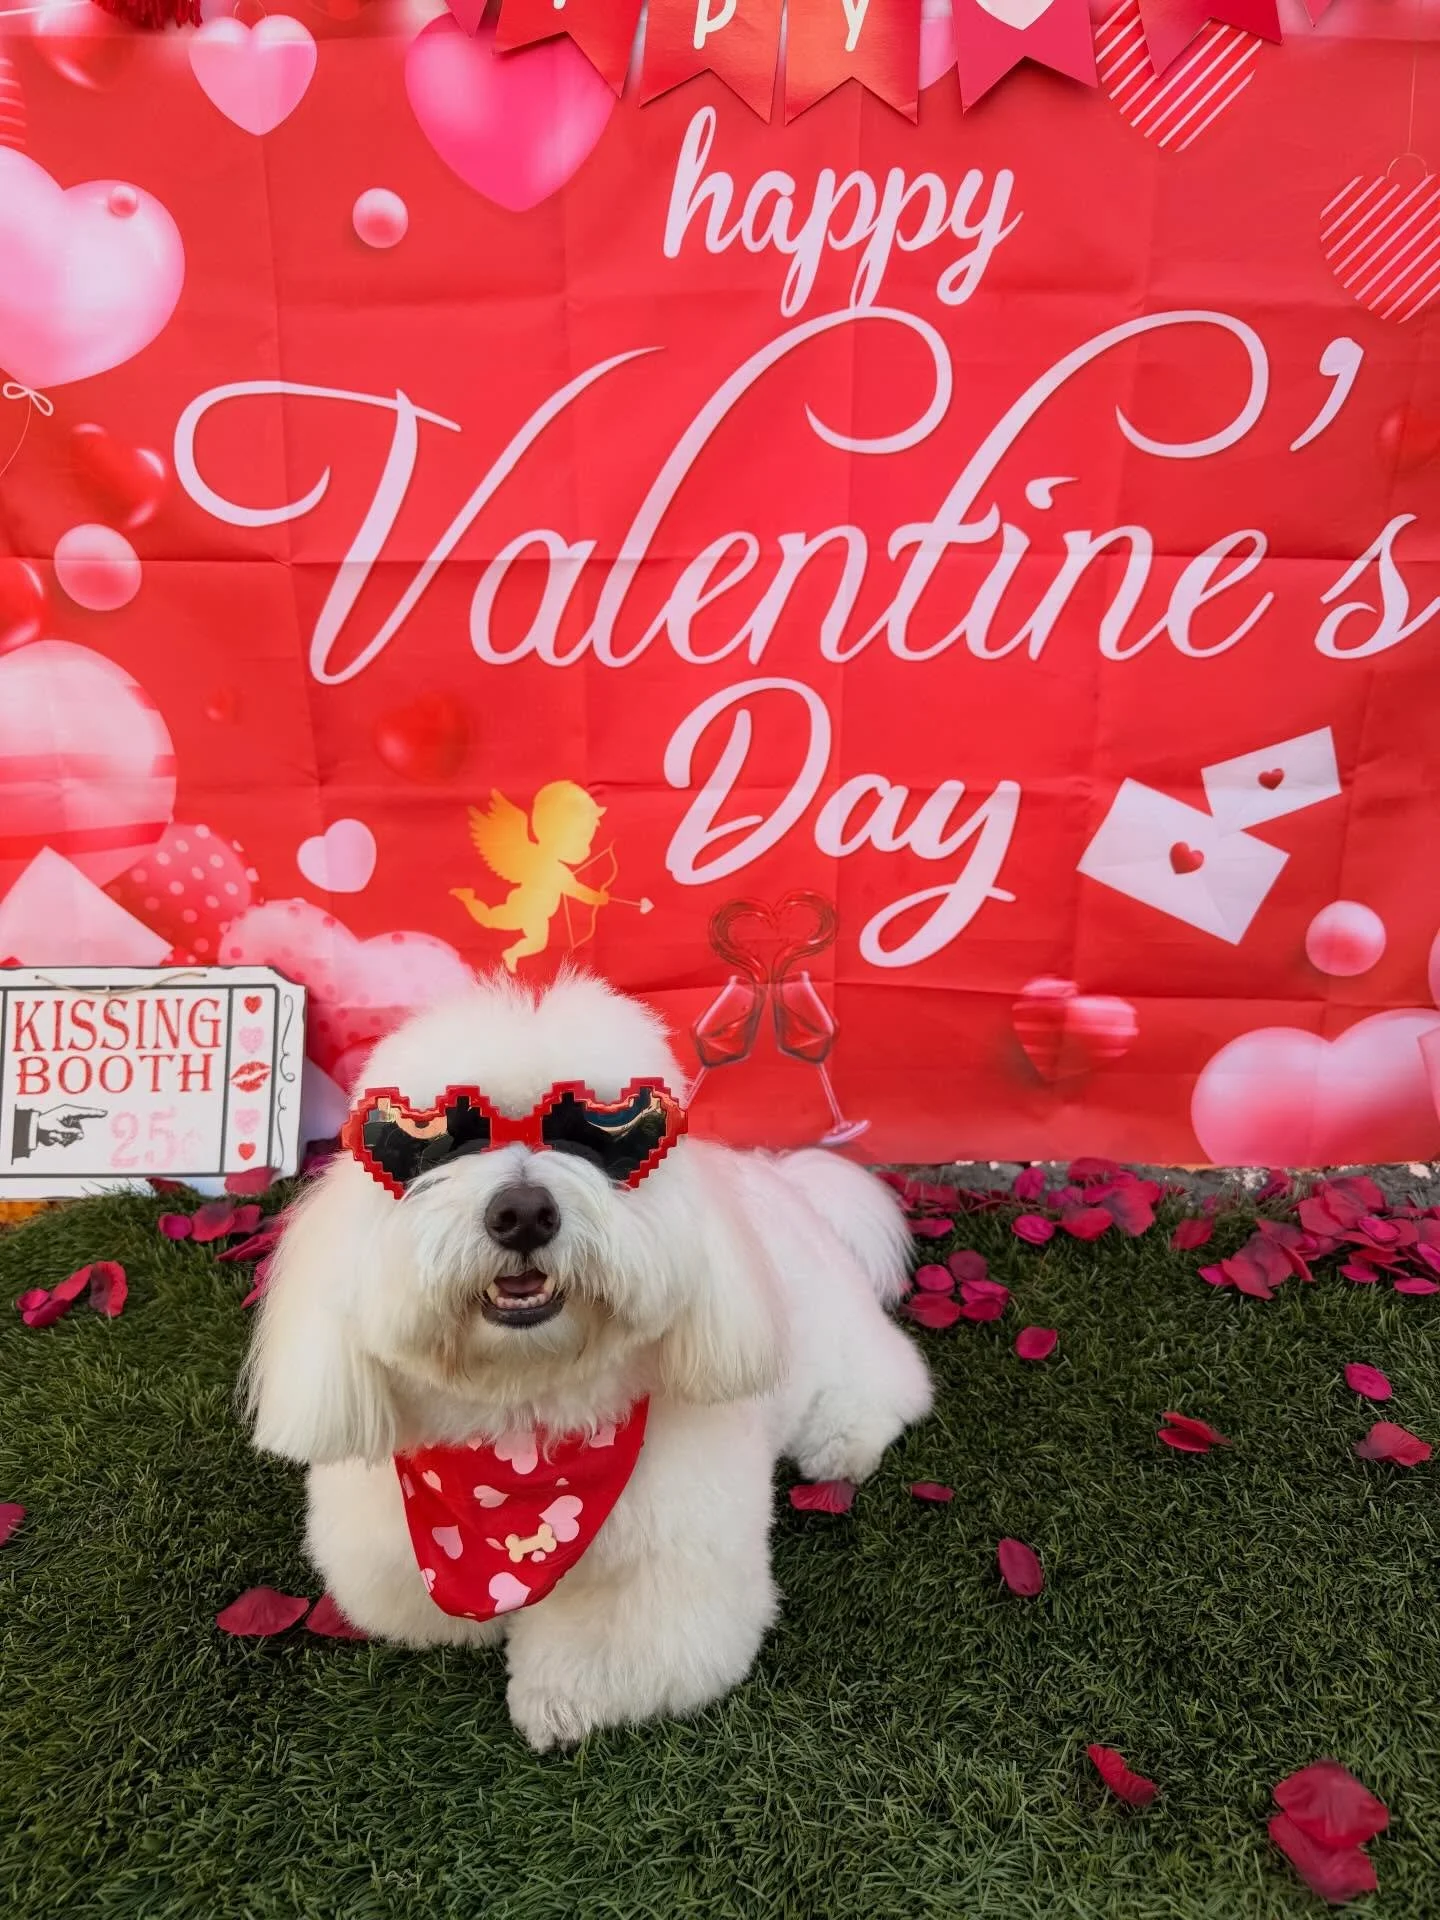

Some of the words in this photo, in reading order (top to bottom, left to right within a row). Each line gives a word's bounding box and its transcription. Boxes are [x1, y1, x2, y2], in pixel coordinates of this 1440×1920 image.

[553, 0, 869, 51] py
[663, 106, 1024, 317] happy
[174, 308, 1440, 684] Valentine's
[664, 677, 1021, 967] Day
[12, 998, 222, 1052] KISSING
[16, 1053, 214, 1096] BOOTH
